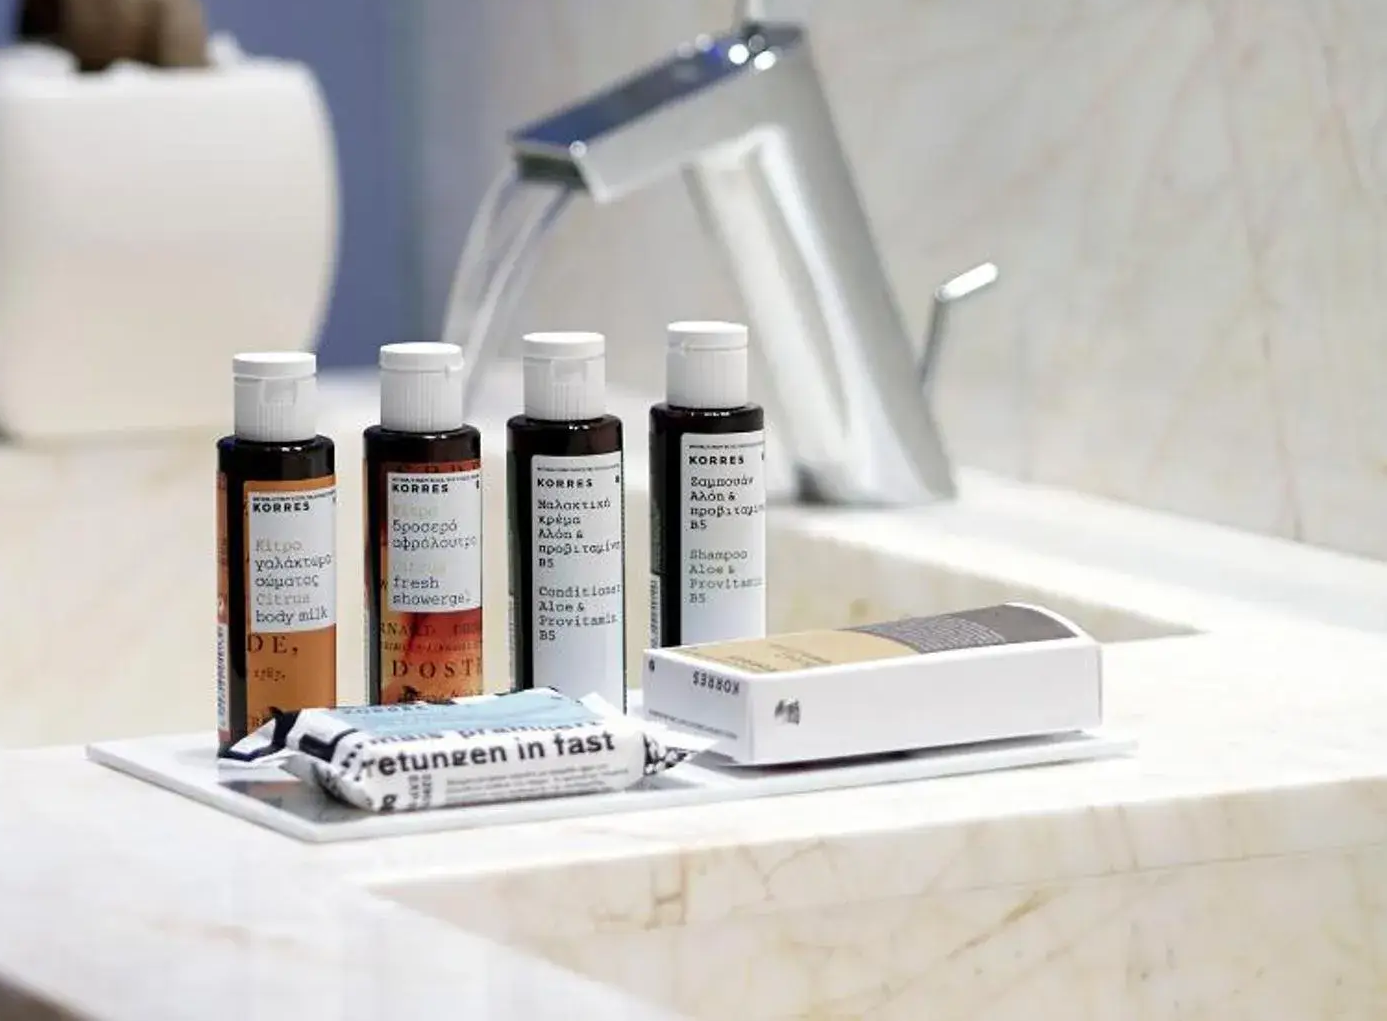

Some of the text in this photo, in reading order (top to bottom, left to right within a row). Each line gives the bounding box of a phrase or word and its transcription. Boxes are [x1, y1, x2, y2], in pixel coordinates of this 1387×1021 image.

[689, 455, 744, 465] KORRES
[392, 483, 449, 493] KORRES
[537, 478, 593, 488] KORRES
[252, 500, 310, 513] KORRES
[690, 549, 748, 561] Shampoo
[689, 564, 724, 574] Aloe
[392, 575, 439, 589] fresh
[538, 600, 573, 612] Aloe
[255, 606, 329, 625] body milk
[692, 670, 740, 696] KORRES
[515, 737, 545, 761] in
[553, 730, 615, 757] fast
